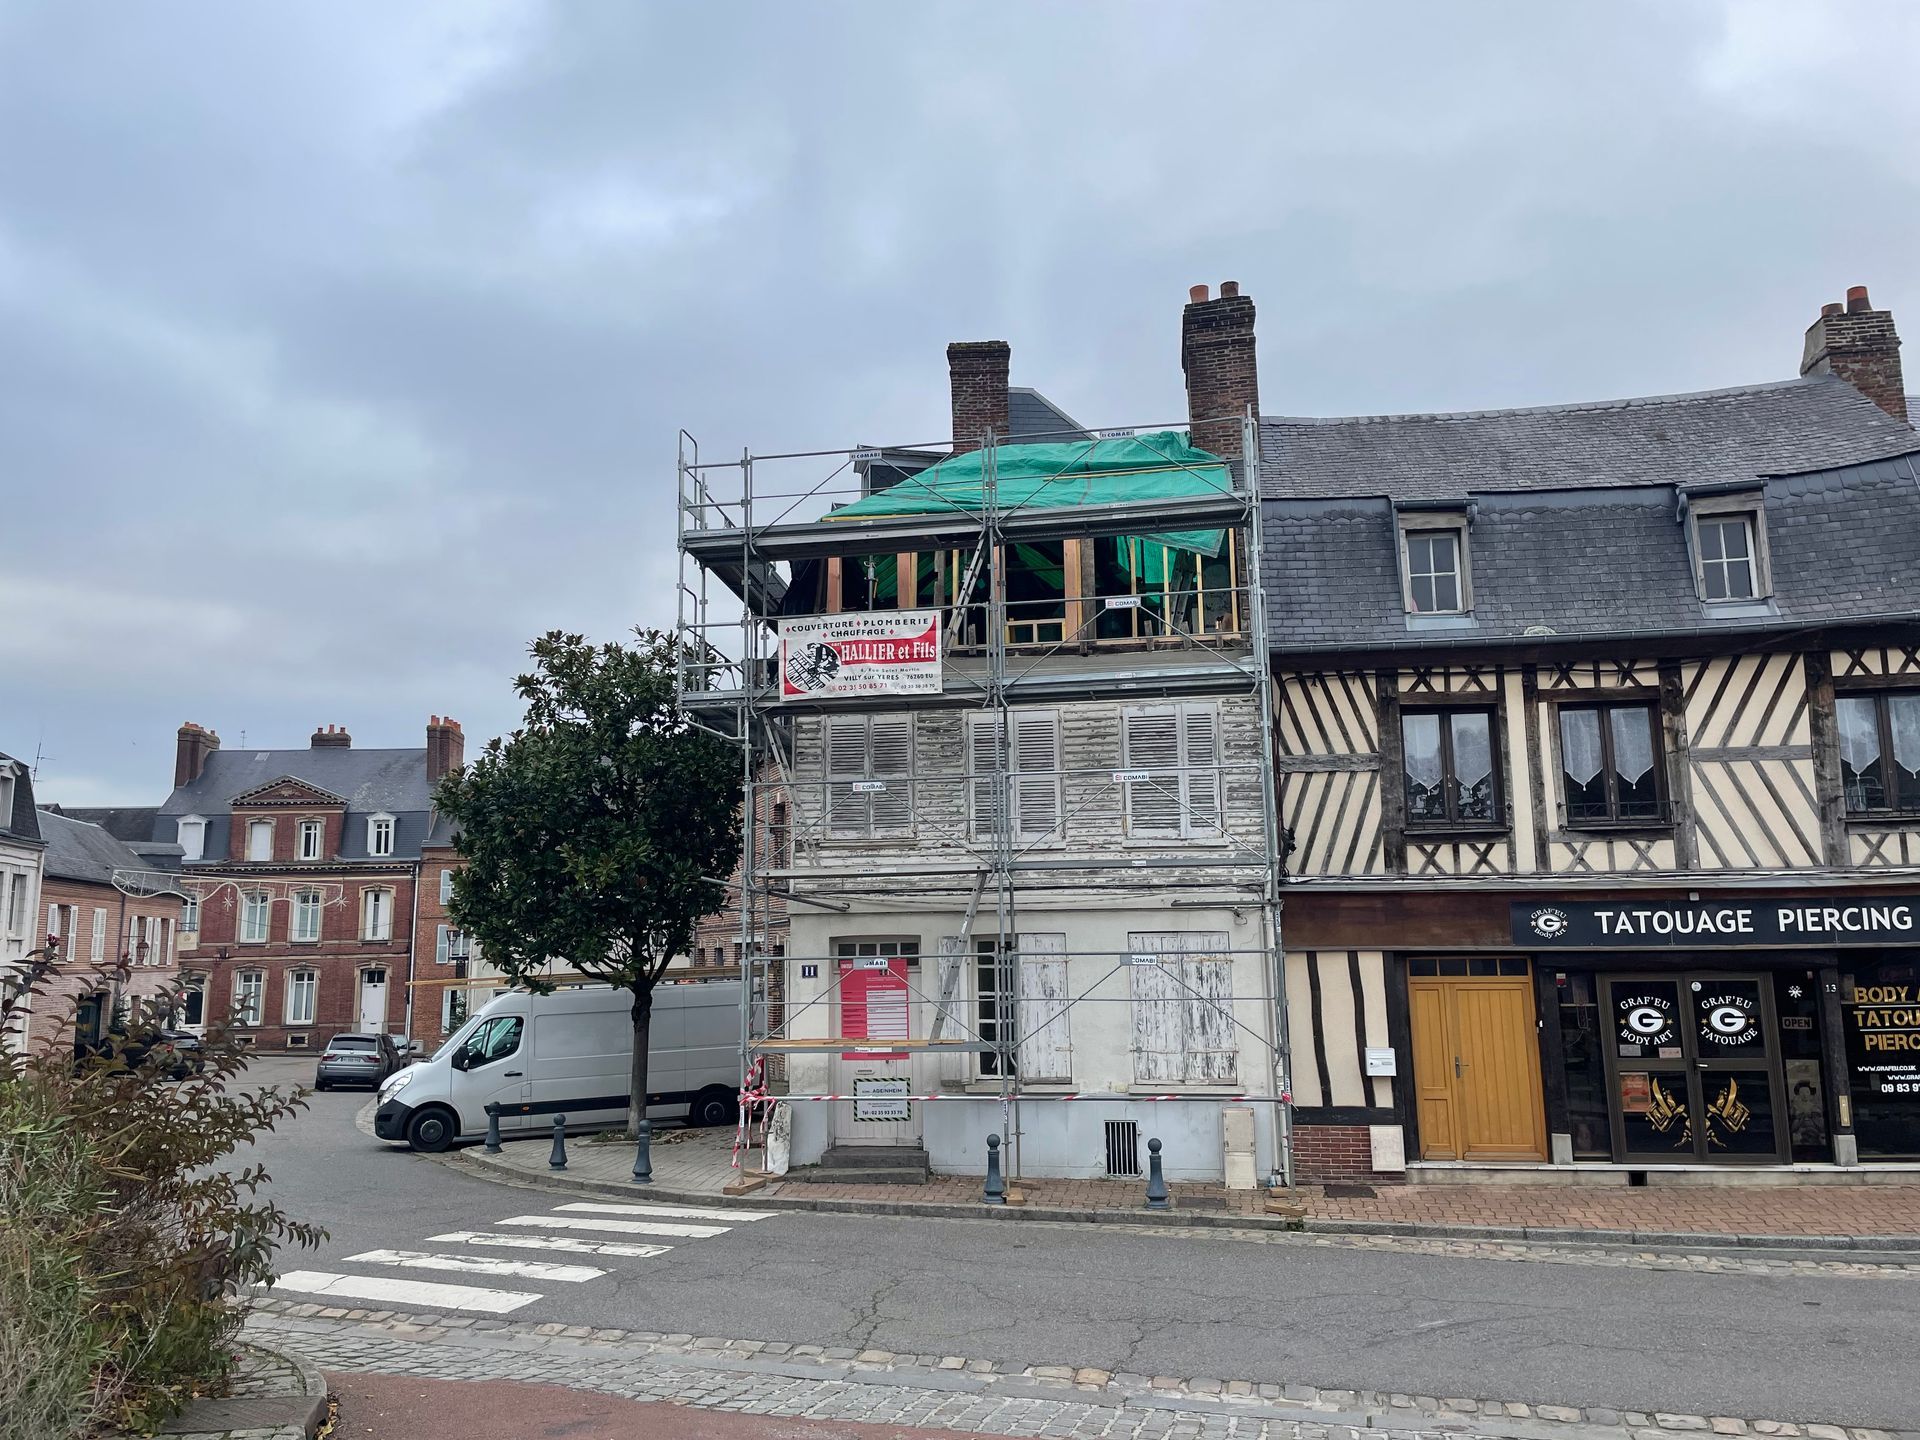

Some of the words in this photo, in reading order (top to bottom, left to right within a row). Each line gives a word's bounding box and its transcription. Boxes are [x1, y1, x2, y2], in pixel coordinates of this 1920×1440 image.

[791, 620, 854, 632] COUVERTURE
[863, 618, 929, 627] PLOMBERIE
[830, 629, 885, 637] CHAUFFAGE
[841, 643, 895, 661] HALLIER
[898, 643, 910, 660] et
[913, 641, 935, 659] Fils
[1593, 909, 1754, 934] TATOUAGE
[1777, 906, 1913, 932] PIERCING
[1534, 927, 1553, 939] Body
[1554, 928, 1567, 937] Art
[805, 966, 815, 976] 11
[1825, 984, 1837, 993] 13
[1853, 986, 1909, 1003] BODY
[1620, 996, 1670, 1010] GRAF'EU
[1701, 995, 1752, 1009] GRAF'EU
[1629, 1008, 1664, 1033] G
[1710, 1007, 1746, 1032] G
[1784, 1019, 1811, 1028] OPEN
[1621, 1028, 1650, 1046] BODY
[1653, 1029, 1673, 1046] ART
[1700, 1026, 1758, 1045] TATOUAGE
[1881, 1083, 1894, 1093] 09
[1896, 1083, 1910, 1093] 83
